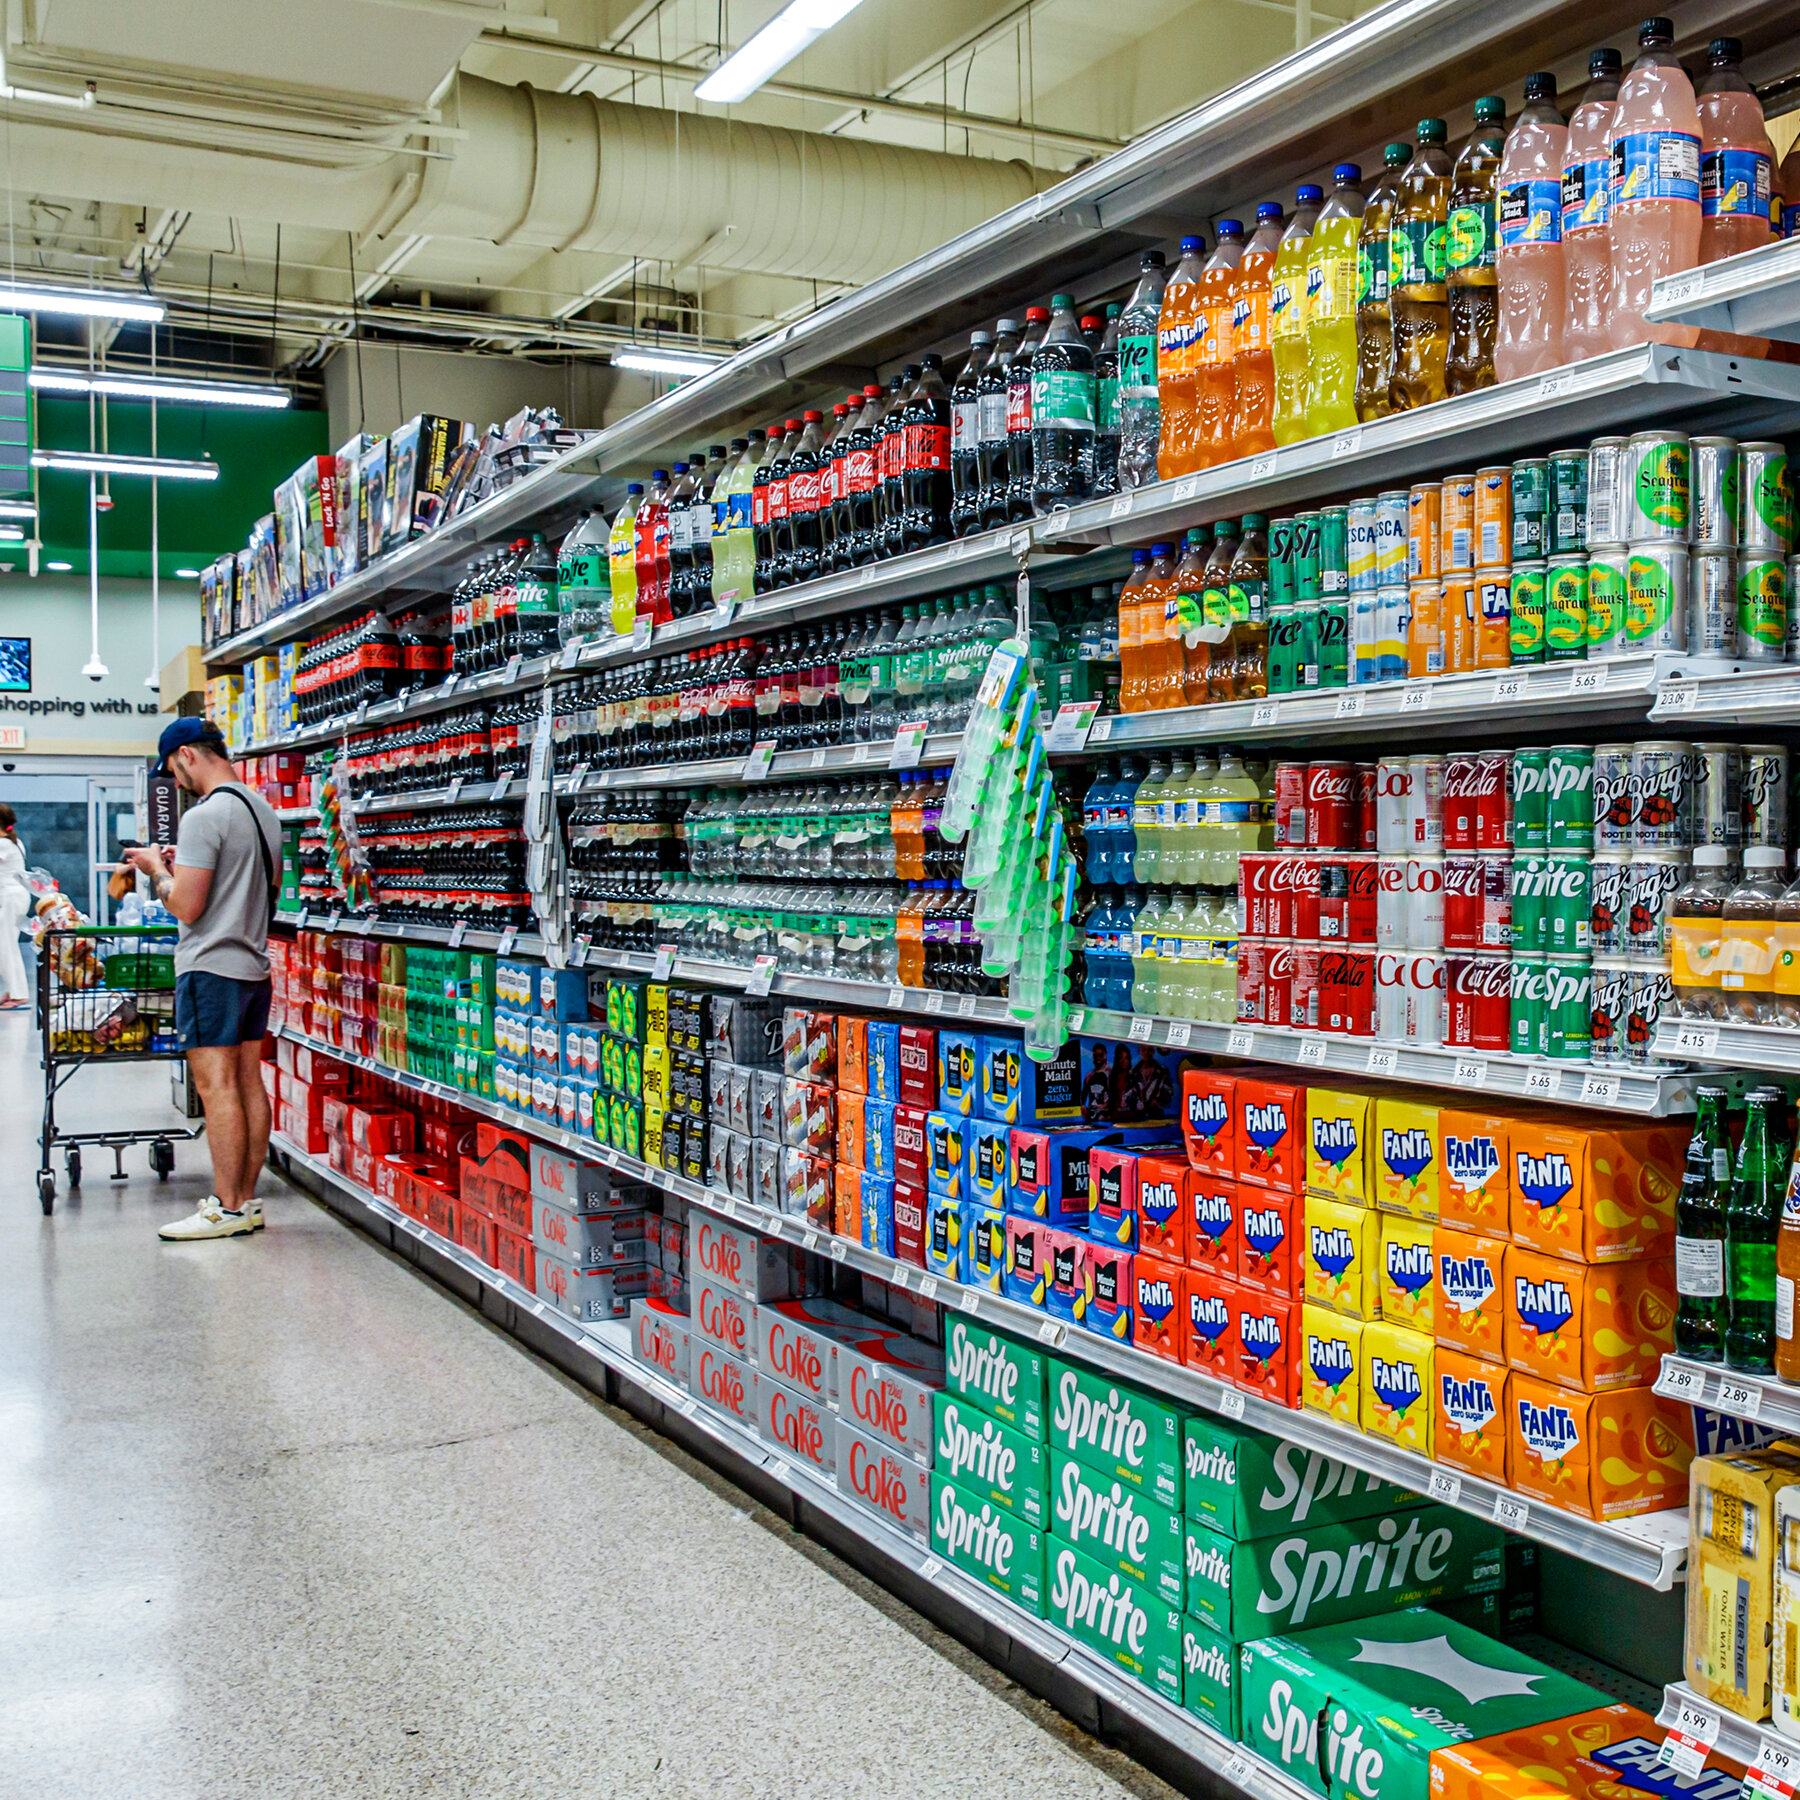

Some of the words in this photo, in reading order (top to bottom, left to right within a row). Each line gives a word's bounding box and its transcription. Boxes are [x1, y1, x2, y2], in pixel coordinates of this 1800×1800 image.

[1542, 382, 1558, 395] 2.29
[1336, 440, 1353, 452] 2.29
[1253, 462, 1270, 475] 2.29
[321, 477, 330, 490] Go
[325, 505, 335, 528] Lock
[1698, 495, 1706, 539] RECYCLE
[1706, 523, 1714, 539] ME
[1454, 614, 1462, 625] ME
[1454, 627, 1462, 668] RECYCLE
[1498, 683, 1518, 695] 5.65
[1575, 675, 1597, 687] 5.65
[90, 697, 132, 714] with
[137, 700, 158, 715] us
[1340, 700, 1357, 711] 5.65
[1405, 693, 1423, 705] 5.65
[1660, 693, 1685, 705] 2/3.09
[1256, 709, 1272, 719] 5.65
[156, 786, 170, 848] GUARAN
[1602, 831, 1624, 839] ROOT
[1635, 831, 1656, 839] ROOT
[1658, 831, 1681, 839] BEER
[1274, 920, 1280, 934] ME
[1597, 938, 1619, 947] BEER
[1637, 940, 1659, 949] BEER
[1274, 1008, 1280, 1023] ME
[1132, 1023, 1147, 1034] 5.65
[1170, 1028, 1184, 1039] 5.65
[1463, 1027, 1470, 1042] ME
[1232, 1036, 1247, 1047] 5.65
[1597, 1046, 1619, 1054] BEER
[1681, 1034, 1705, 1047] 4.15
[1303, 1046, 1319, 1057] 5.65
[1372, 1054, 1389, 1066] 5.65
[1040, 1059, 1076, 1071] Minute
[1459, 1066, 1478, 1078] 5.65
[1044, 1070, 1071, 1082] Maid
[1531, 1075, 1550, 1088] 5.65
[1044, 1093, 1072, 1103] sugar
[1047, 1084, 1069, 1094] zero
[1587, 1082, 1609, 1096] 5.65
[1043, 1108, 1074, 1116] Lemonade
[1188, 1094, 1228, 1122] FANTA
[1245, 1104, 1287, 1133] FANTA
[1312, 1117, 1357, 1147] FANTA
[1383, 1129, 1432, 1160] FANTA
[1446, 1137, 1499, 1170] FANTA
[1454, 1168, 1467, 1178] zero
[1468, 1168, 1487, 1179] sugar
[1516, 1153, 1573, 1187] FANTA
[1142, 1183, 1177, 1208] FANTA
[1195, 1194, 1233, 1222] FANTA
[1243, 1209, 1284, 1236] FANTA
[1311, 1227, 1354, 1257] FANTA
[699, 1223, 741, 1285] Coke
[1387, 1244, 1433, 1275] FANTA
[1441, 1255, 1494, 1289] FANTA
[1138, 1279, 1174, 1307] FANTA
[1450, 1288, 1464, 1298] zero
[1465, 1288, 1484, 1299] sugar
[1515, 1277, 1573, 1315] FANTA
[700, 1287, 745, 1350] Coke
[1190, 1294, 1229, 1324] FANTA
[1240, 1312, 1281, 1344] FANTA
[640, 1314, 676, 1375] Coke
[802, 1334, 817, 1354] Diet
[1309, 1336, 1353, 1369] FANTA
[769, 1323, 822, 1392] Coke
[949, 1322, 1019, 1405] Sprite
[700, 1352, 744, 1416] Coke
[1372, 1357, 1421, 1394] FANTA
[1667, 1371, 1691, 1388] 2.89
[887, 1378, 904, 1401] Diet
[1443, 1375, 1494, 1412] FANTA
[1723, 1386, 1748, 1403] 2.89
[851, 1366, 907, 1443] Coke
[804, 1404, 819, 1425] Diet
[1054, 1371, 1148, 1467] Sprite
[1165, 1417, 1174, 1431] 12
[1450, 1409, 1464, 1419] zero
[1465, 1411, 1484, 1422] sugar
[1519, 1401, 1577, 1440] FANTA
[770, 1392, 823, 1465] Coke
[940, 1404, 1016, 1491] Sprite
[1529, 1436, 1544, 1447] zero
[1545, 1439, 1566, 1450] sugar
[887, 1455, 904, 1477] Diet
[1186, 1437, 1236, 1486] Sprite
[850, 1441, 908, 1520] Coke
[1434, 1478, 1452, 1492] 10.29
[1056, 1461, 1150, 1563] Sprite
[1500, 1503, 1519, 1518] 10.29
[936, 1485, 1014, 1576] Sprite
[1169, 1516, 1179, 1530] 12
[1186, 1535, 1231, 1589] Sprite
[1256, 1518, 1452, 1625] Sprite
[1051, 1550, 1148, 1656] Sprite
[1168, 1611, 1180, 1625] 12
[1736, 1596, 1747, 1681] FEVER-TREE
[1183, 1632, 1231, 1687] Sprite
[1240, 1648, 1254, 1665] 24
[1720, 1630, 1728, 1671] WATER
[1410, 1706, 1474, 1740] Sprite
[1682, 1710, 1707, 1729] 6.99
[1262, 1679, 1384, 1799] Sprite
[1680, 1735, 1698, 1749] save
[1576, 1757, 1615, 1775] orange
[1763, 1749, 1790, 1768] 6.99
[1431, 1764, 1445, 1784] 24
[1760, 1773, 1780, 1789] save
